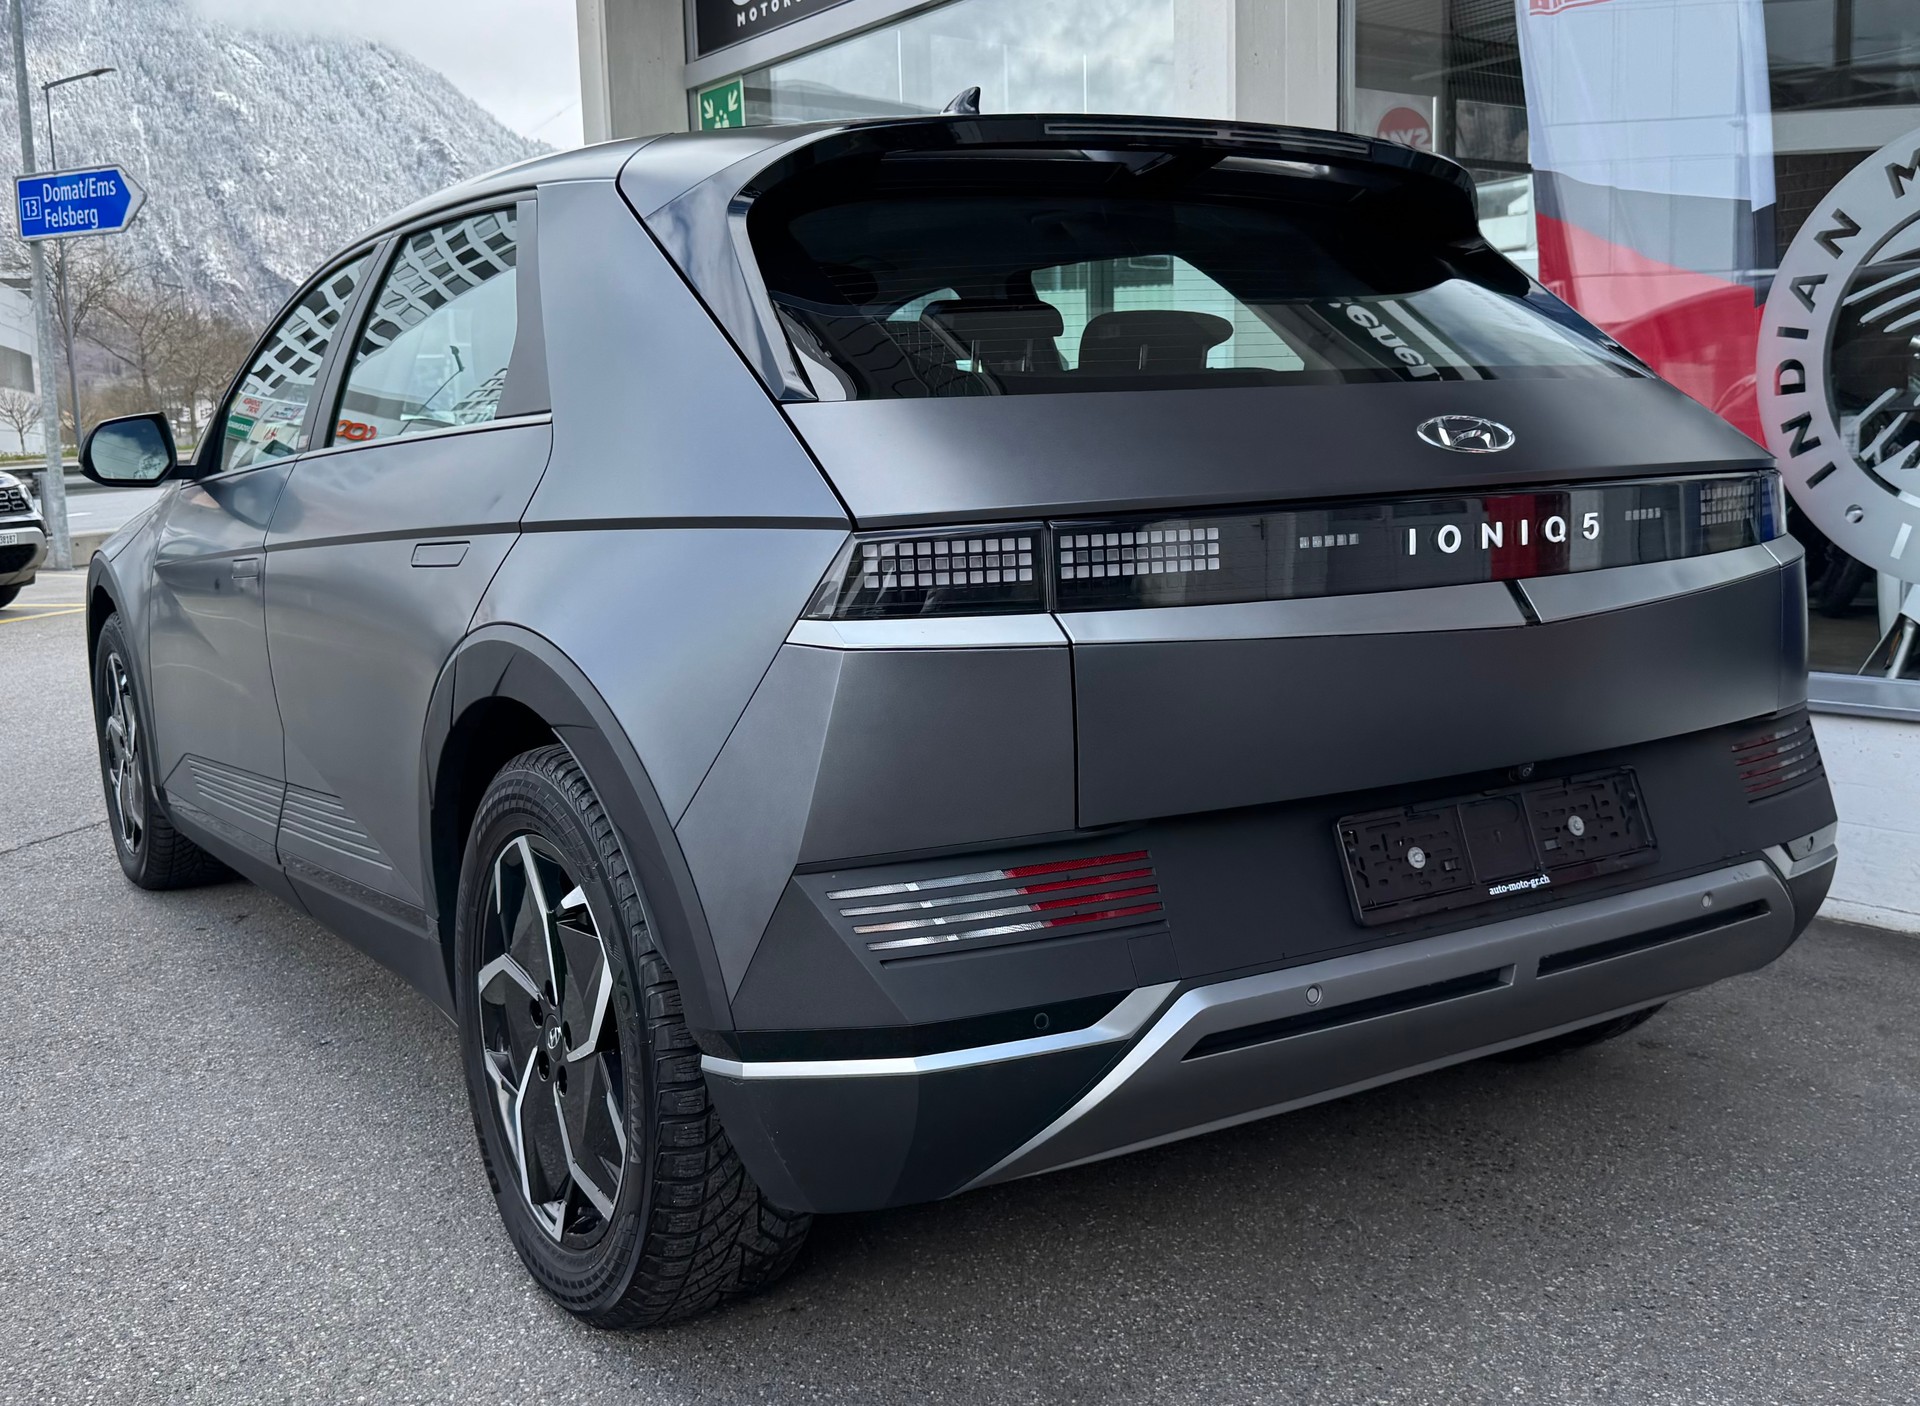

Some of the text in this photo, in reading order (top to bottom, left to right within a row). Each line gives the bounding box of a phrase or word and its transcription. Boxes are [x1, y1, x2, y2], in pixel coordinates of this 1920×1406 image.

[42, 177, 117, 203] Domat/Ems
[25, 200, 38, 217] 13
[44, 205, 99, 229] Felsberg
[1775, 207, 1862, 490] INDIAN
[1488, 874, 1551, 896] auto-moto-gr.ch
